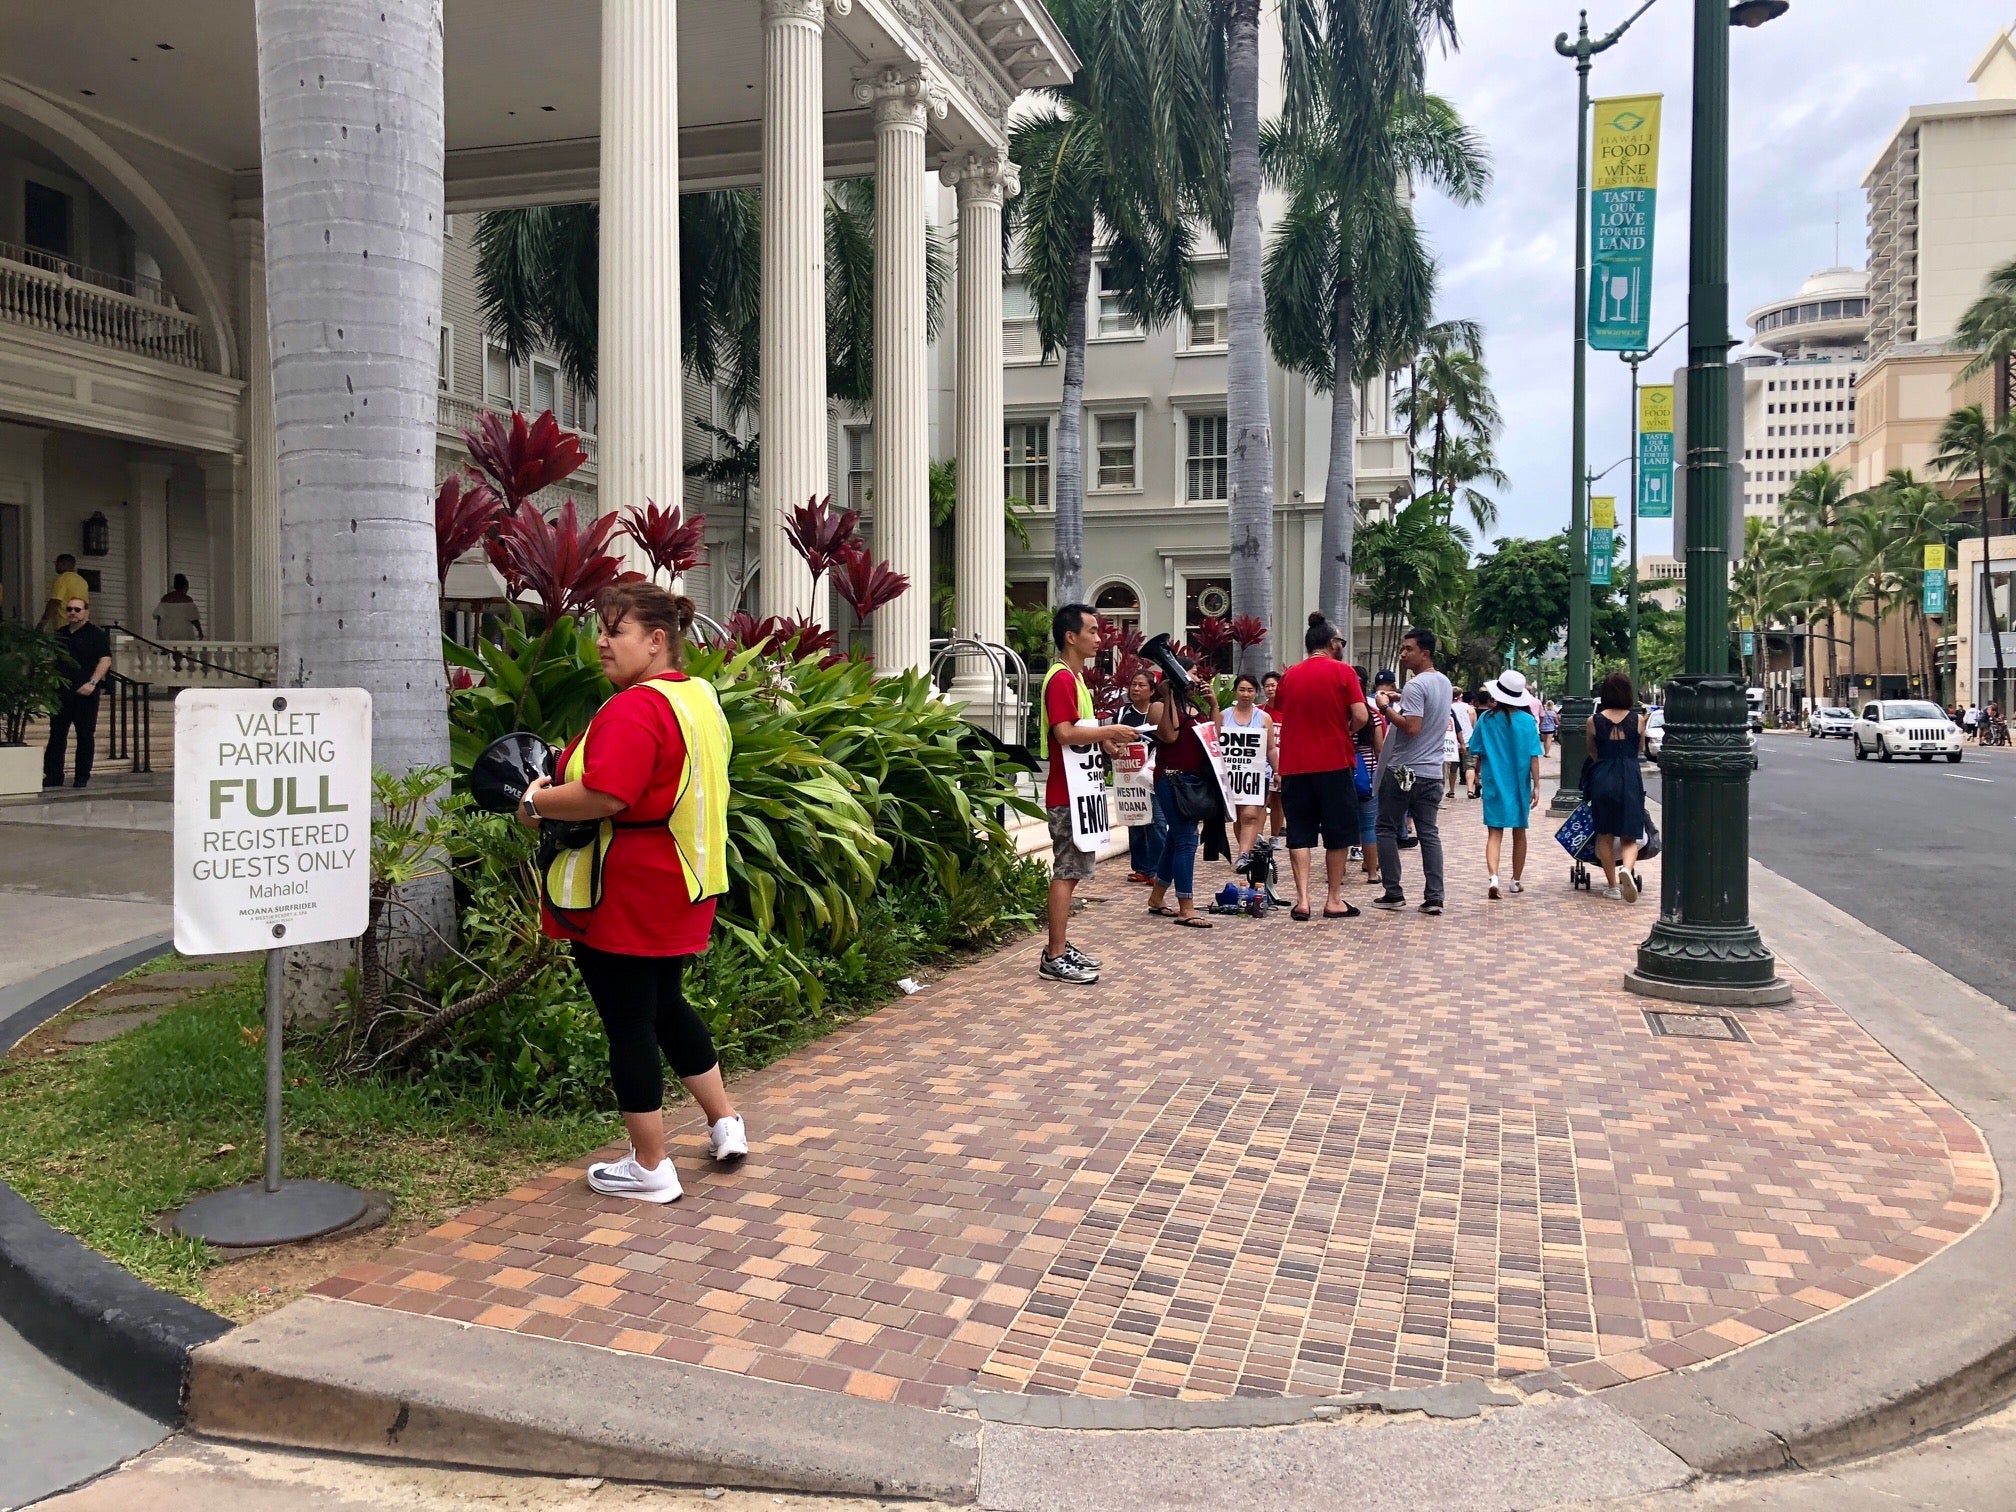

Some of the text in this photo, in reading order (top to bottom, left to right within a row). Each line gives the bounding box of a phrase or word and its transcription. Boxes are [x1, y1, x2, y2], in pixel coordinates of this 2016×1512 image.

[1601, 143, 1651, 159] FOOD
[1620, 155, 1631, 165] &
[1604, 163, 1647, 176] WINE
[1598, 176, 1651, 185] FESTIVAL
[1602, 190, 1646, 203] TASTE
[1609, 203, 1636, 213] OUR
[1600, 212, 1646, 227] LOVE
[1599, 226, 1646, 237] FOR THE
[1599, 237, 1646, 250] LAND
[1644, 409, 1671, 417] FOOD
[1644, 445, 1670, 453] LOVE
[1643, 457, 1669, 465] LAND
[235, 712, 320, 737] VALET
[1220, 732, 1260, 748] ONE
[219, 740, 335, 766] PARKING
[1221, 748, 1257, 757] JOB
[1079, 754, 1104, 770] JO
[1227, 771, 1260, 795] OUGH
[209, 775, 349, 820] FULL
[503, 783, 522, 799] PYLE
[1116, 786, 1146, 798] WESTIN
[1077, 793, 1109, 835] ENOU
[1118, 801, 1148, 812] MOANA
[203, 823, 349, 853] REGISTERED
[192, 848, 356, 881] GUESTS ONLY
[249, 880, 309, 899] Mahalo!
[239, 901, 317, 916] MOANA SURFRIDER
